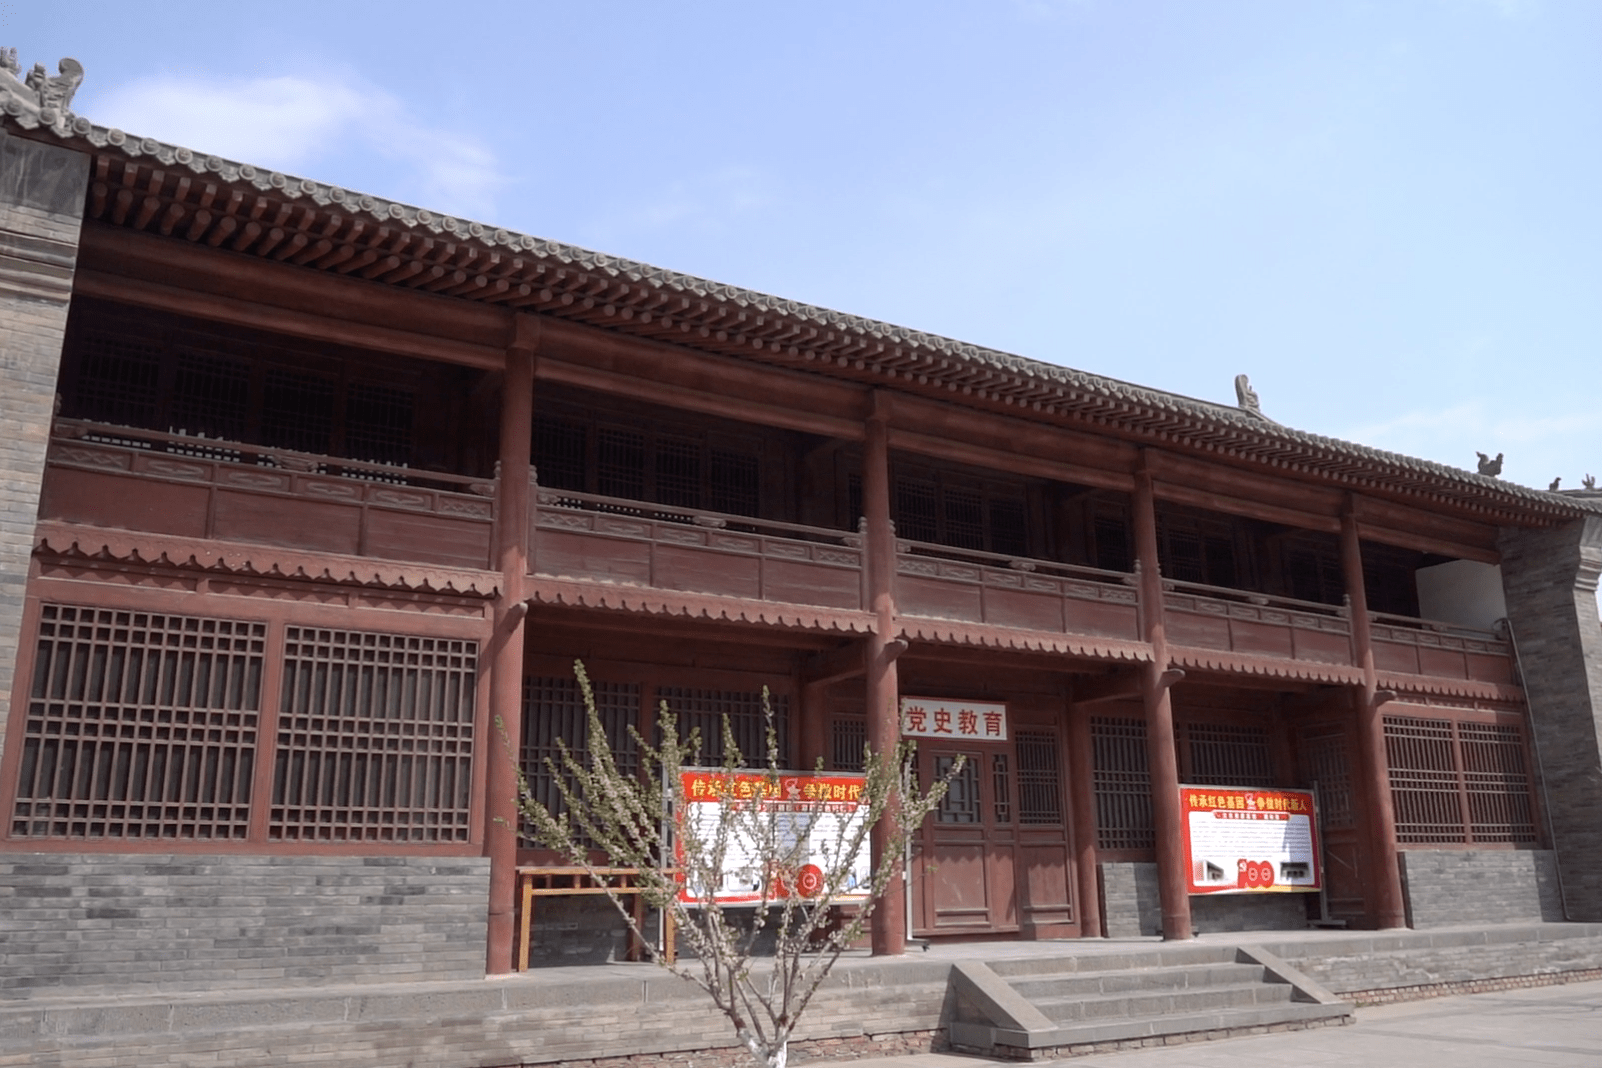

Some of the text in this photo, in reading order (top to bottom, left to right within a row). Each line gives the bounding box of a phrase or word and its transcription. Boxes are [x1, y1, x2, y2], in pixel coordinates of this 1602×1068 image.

[906, 705, 1002, 736] 党史教育
[1189, 793, 1307, 811] 传承红色基因 争做时代新人
